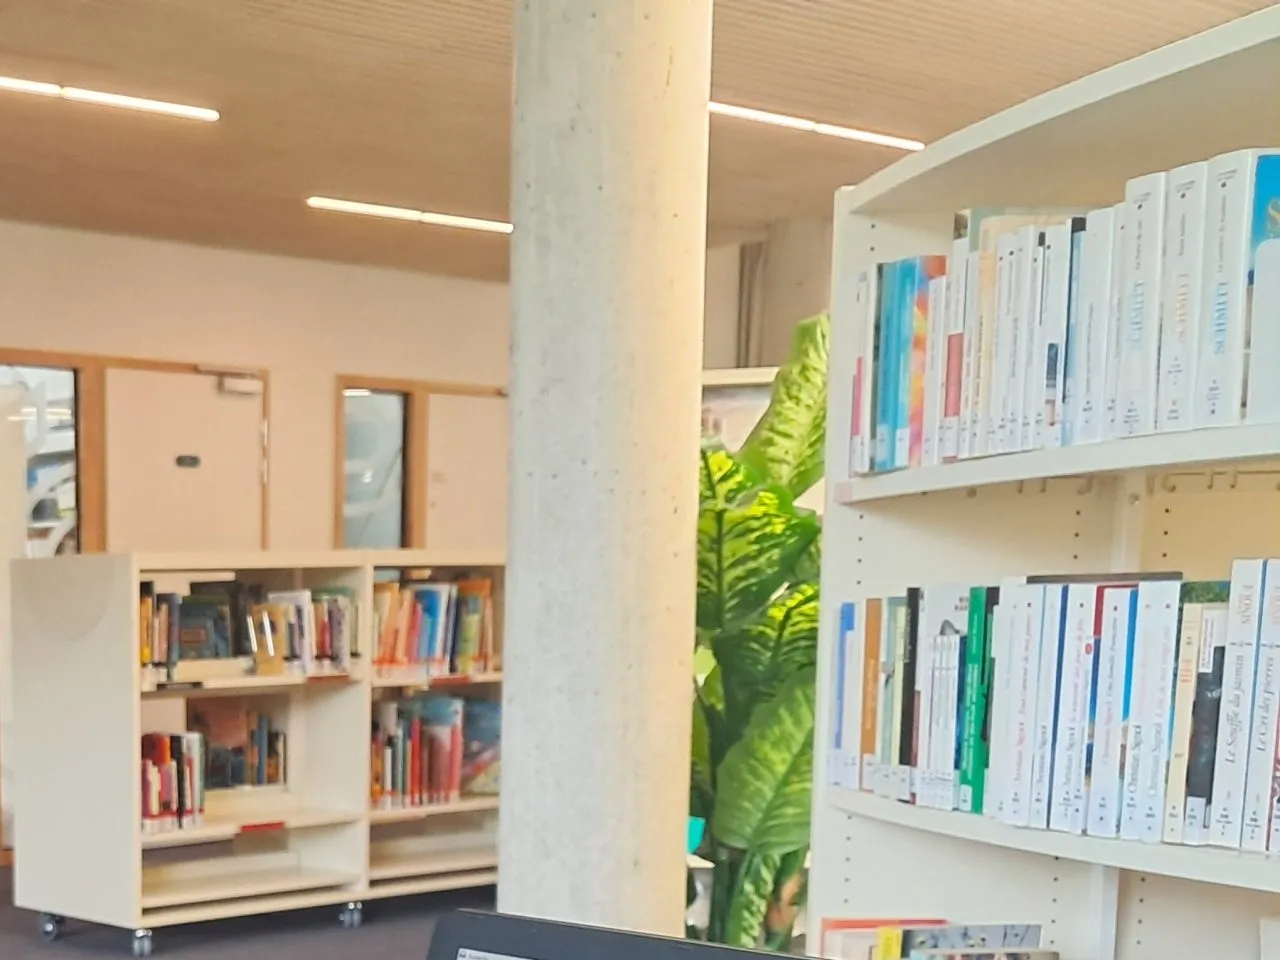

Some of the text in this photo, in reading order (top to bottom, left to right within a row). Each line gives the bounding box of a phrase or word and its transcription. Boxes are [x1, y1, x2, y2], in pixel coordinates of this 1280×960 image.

[1231, 654, 1245, 694] jasmin
[1228, 693, 1240, 708] du
[1131, 724, 1144, 750] Signol
[1224, 710, 1242, 746] Souffle
[1256, 737, 1267, 752] Le
[1224, 750, 1236, 765] Le
